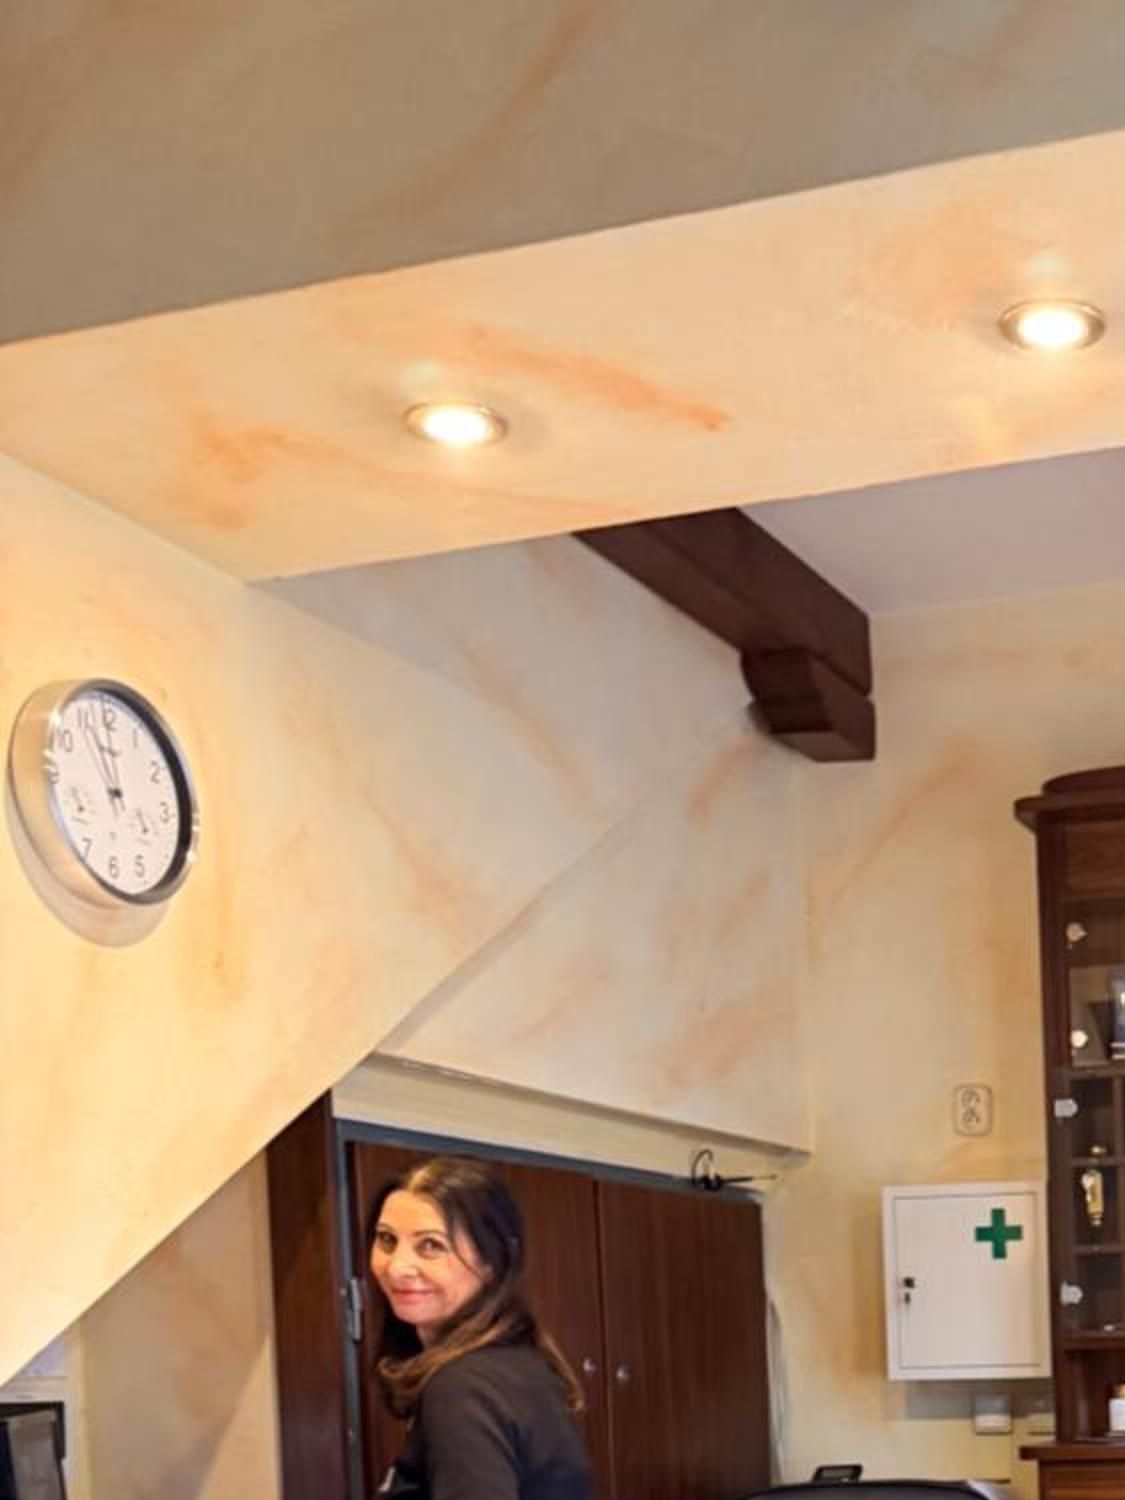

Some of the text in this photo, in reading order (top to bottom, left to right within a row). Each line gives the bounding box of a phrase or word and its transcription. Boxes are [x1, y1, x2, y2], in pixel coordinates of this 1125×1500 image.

[149, 760, 161, 784] 2
[160, 801, 170, 824] 3
[108, 855, 120, 879] 6
[134, 854, 145, 879] 5
